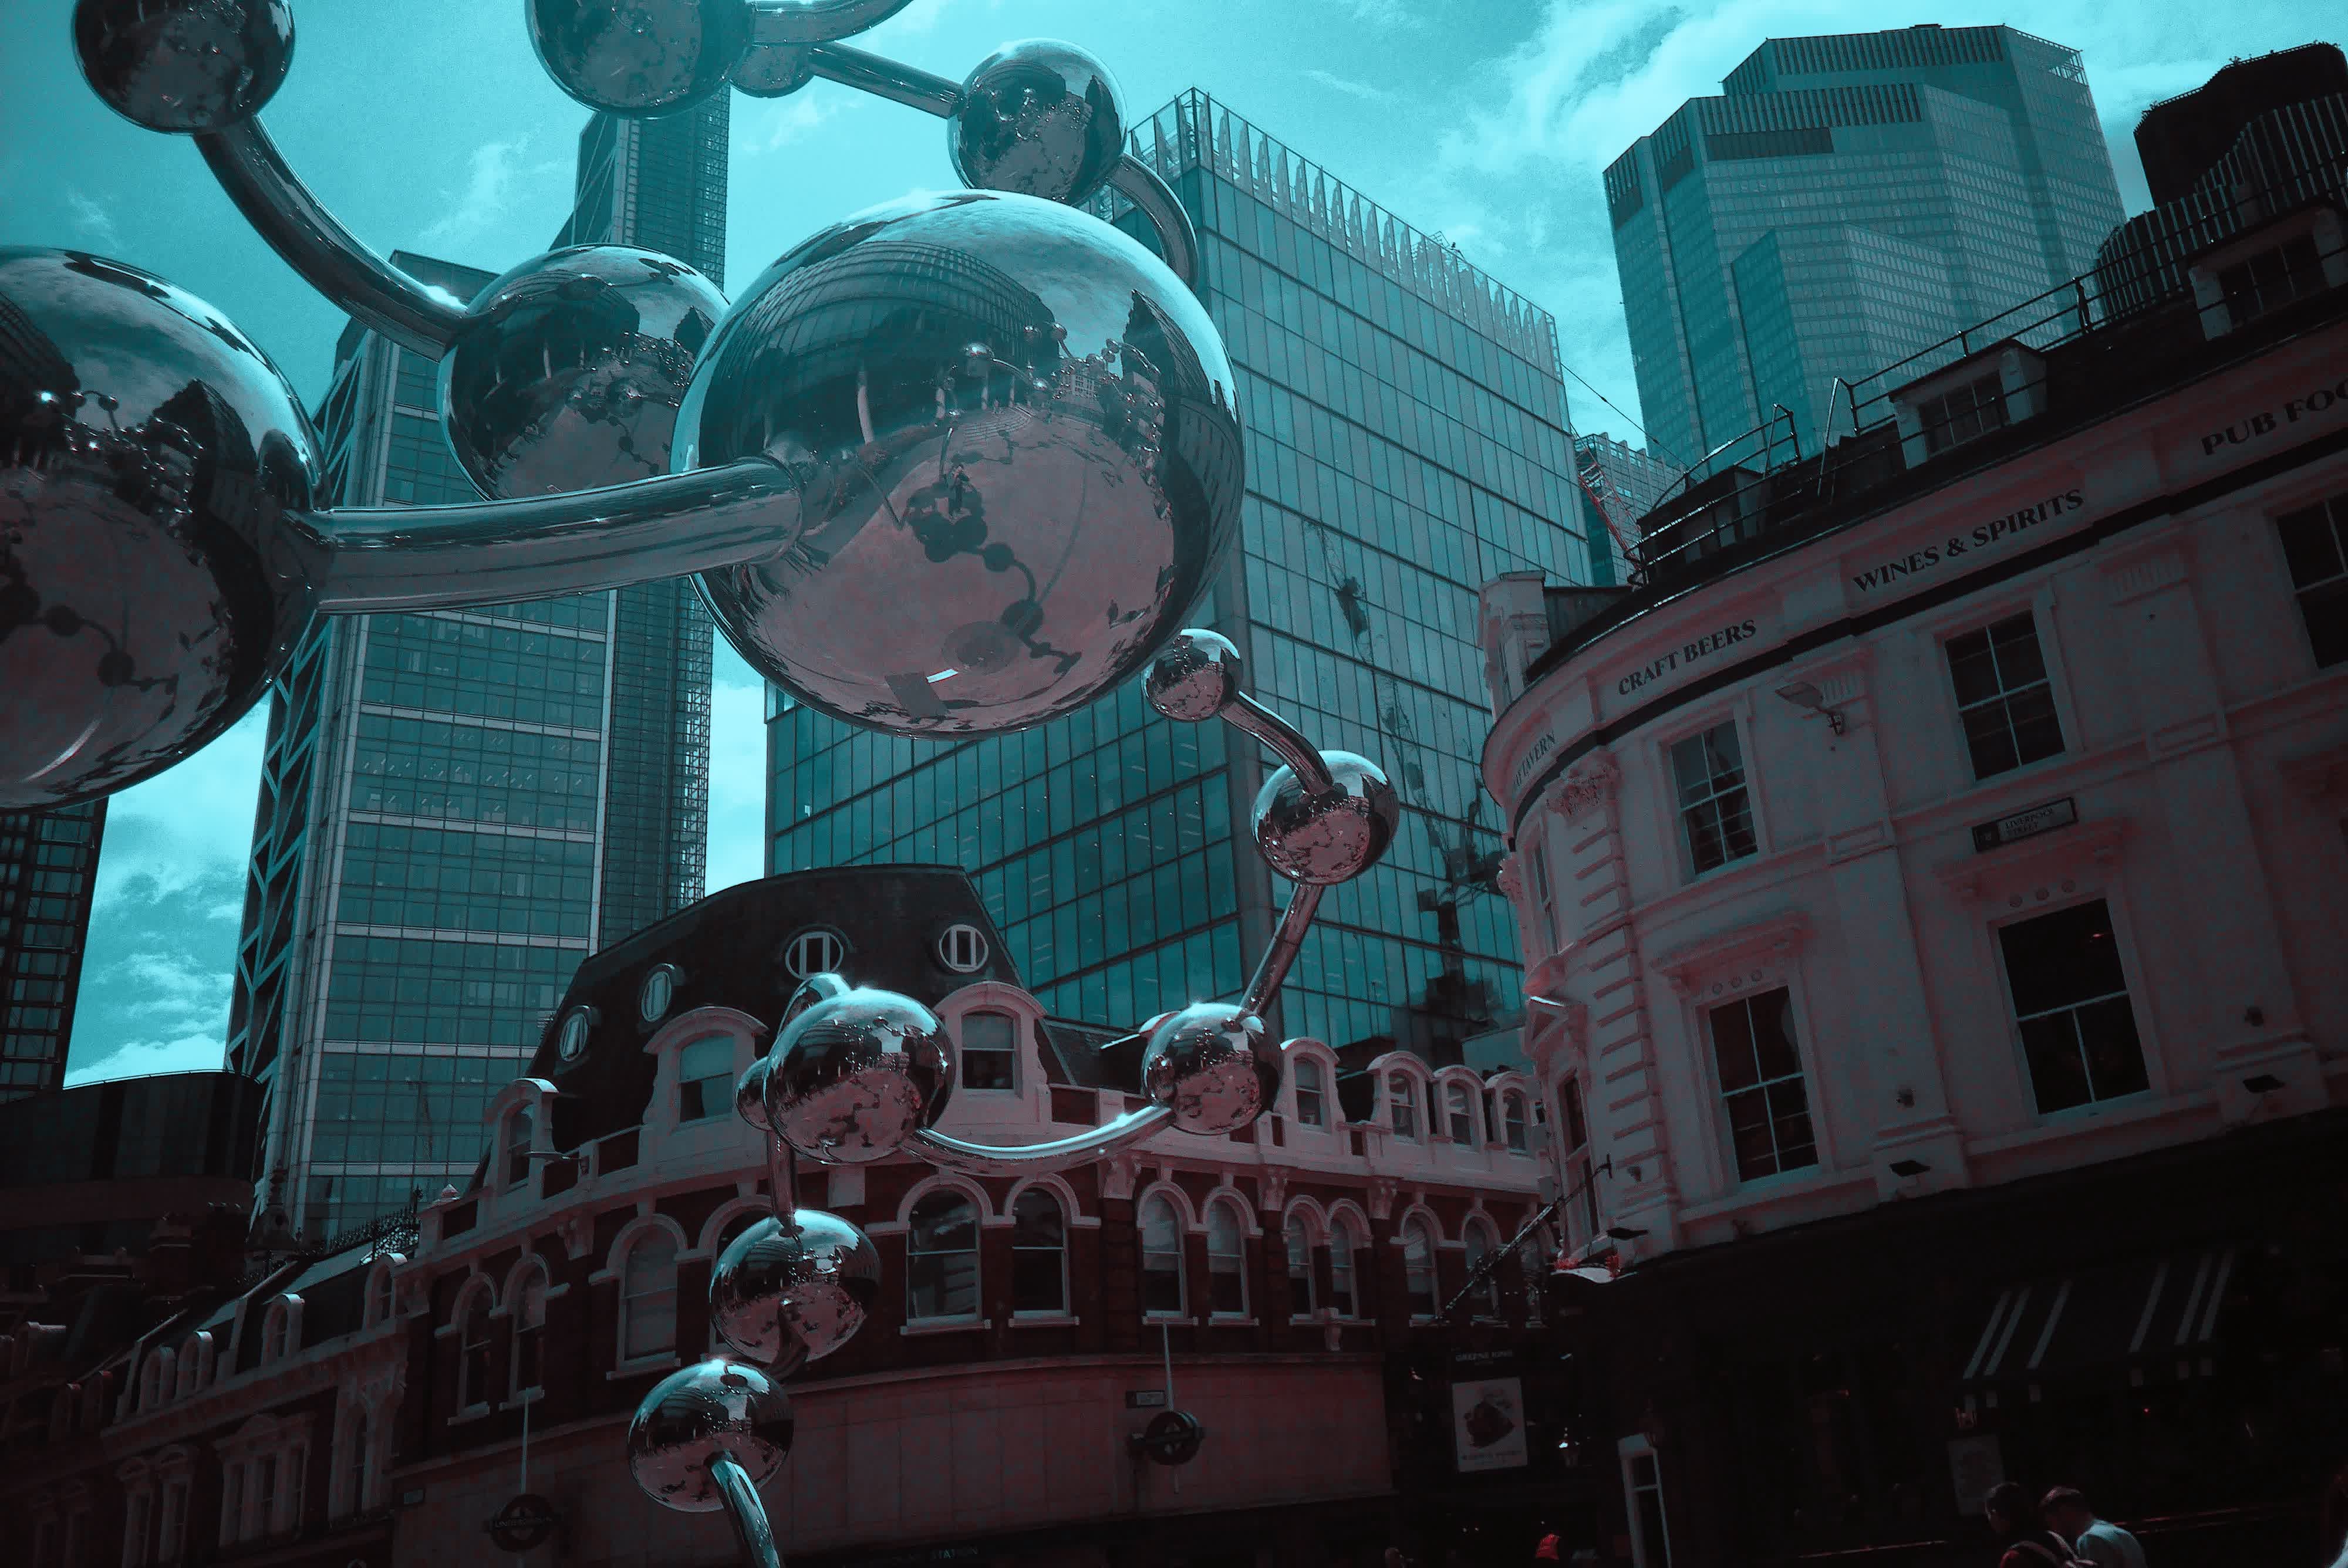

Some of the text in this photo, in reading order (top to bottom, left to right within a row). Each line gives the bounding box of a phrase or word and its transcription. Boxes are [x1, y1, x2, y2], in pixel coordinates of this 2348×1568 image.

[2201, 412, 2276, 455] PUB
[1853, 488, 2084, 592] WINES & SPIRITS
[1618, 619, 1756, 695] CRAFT BEERS
[1521, 730, 1556, 776] TAVERN
